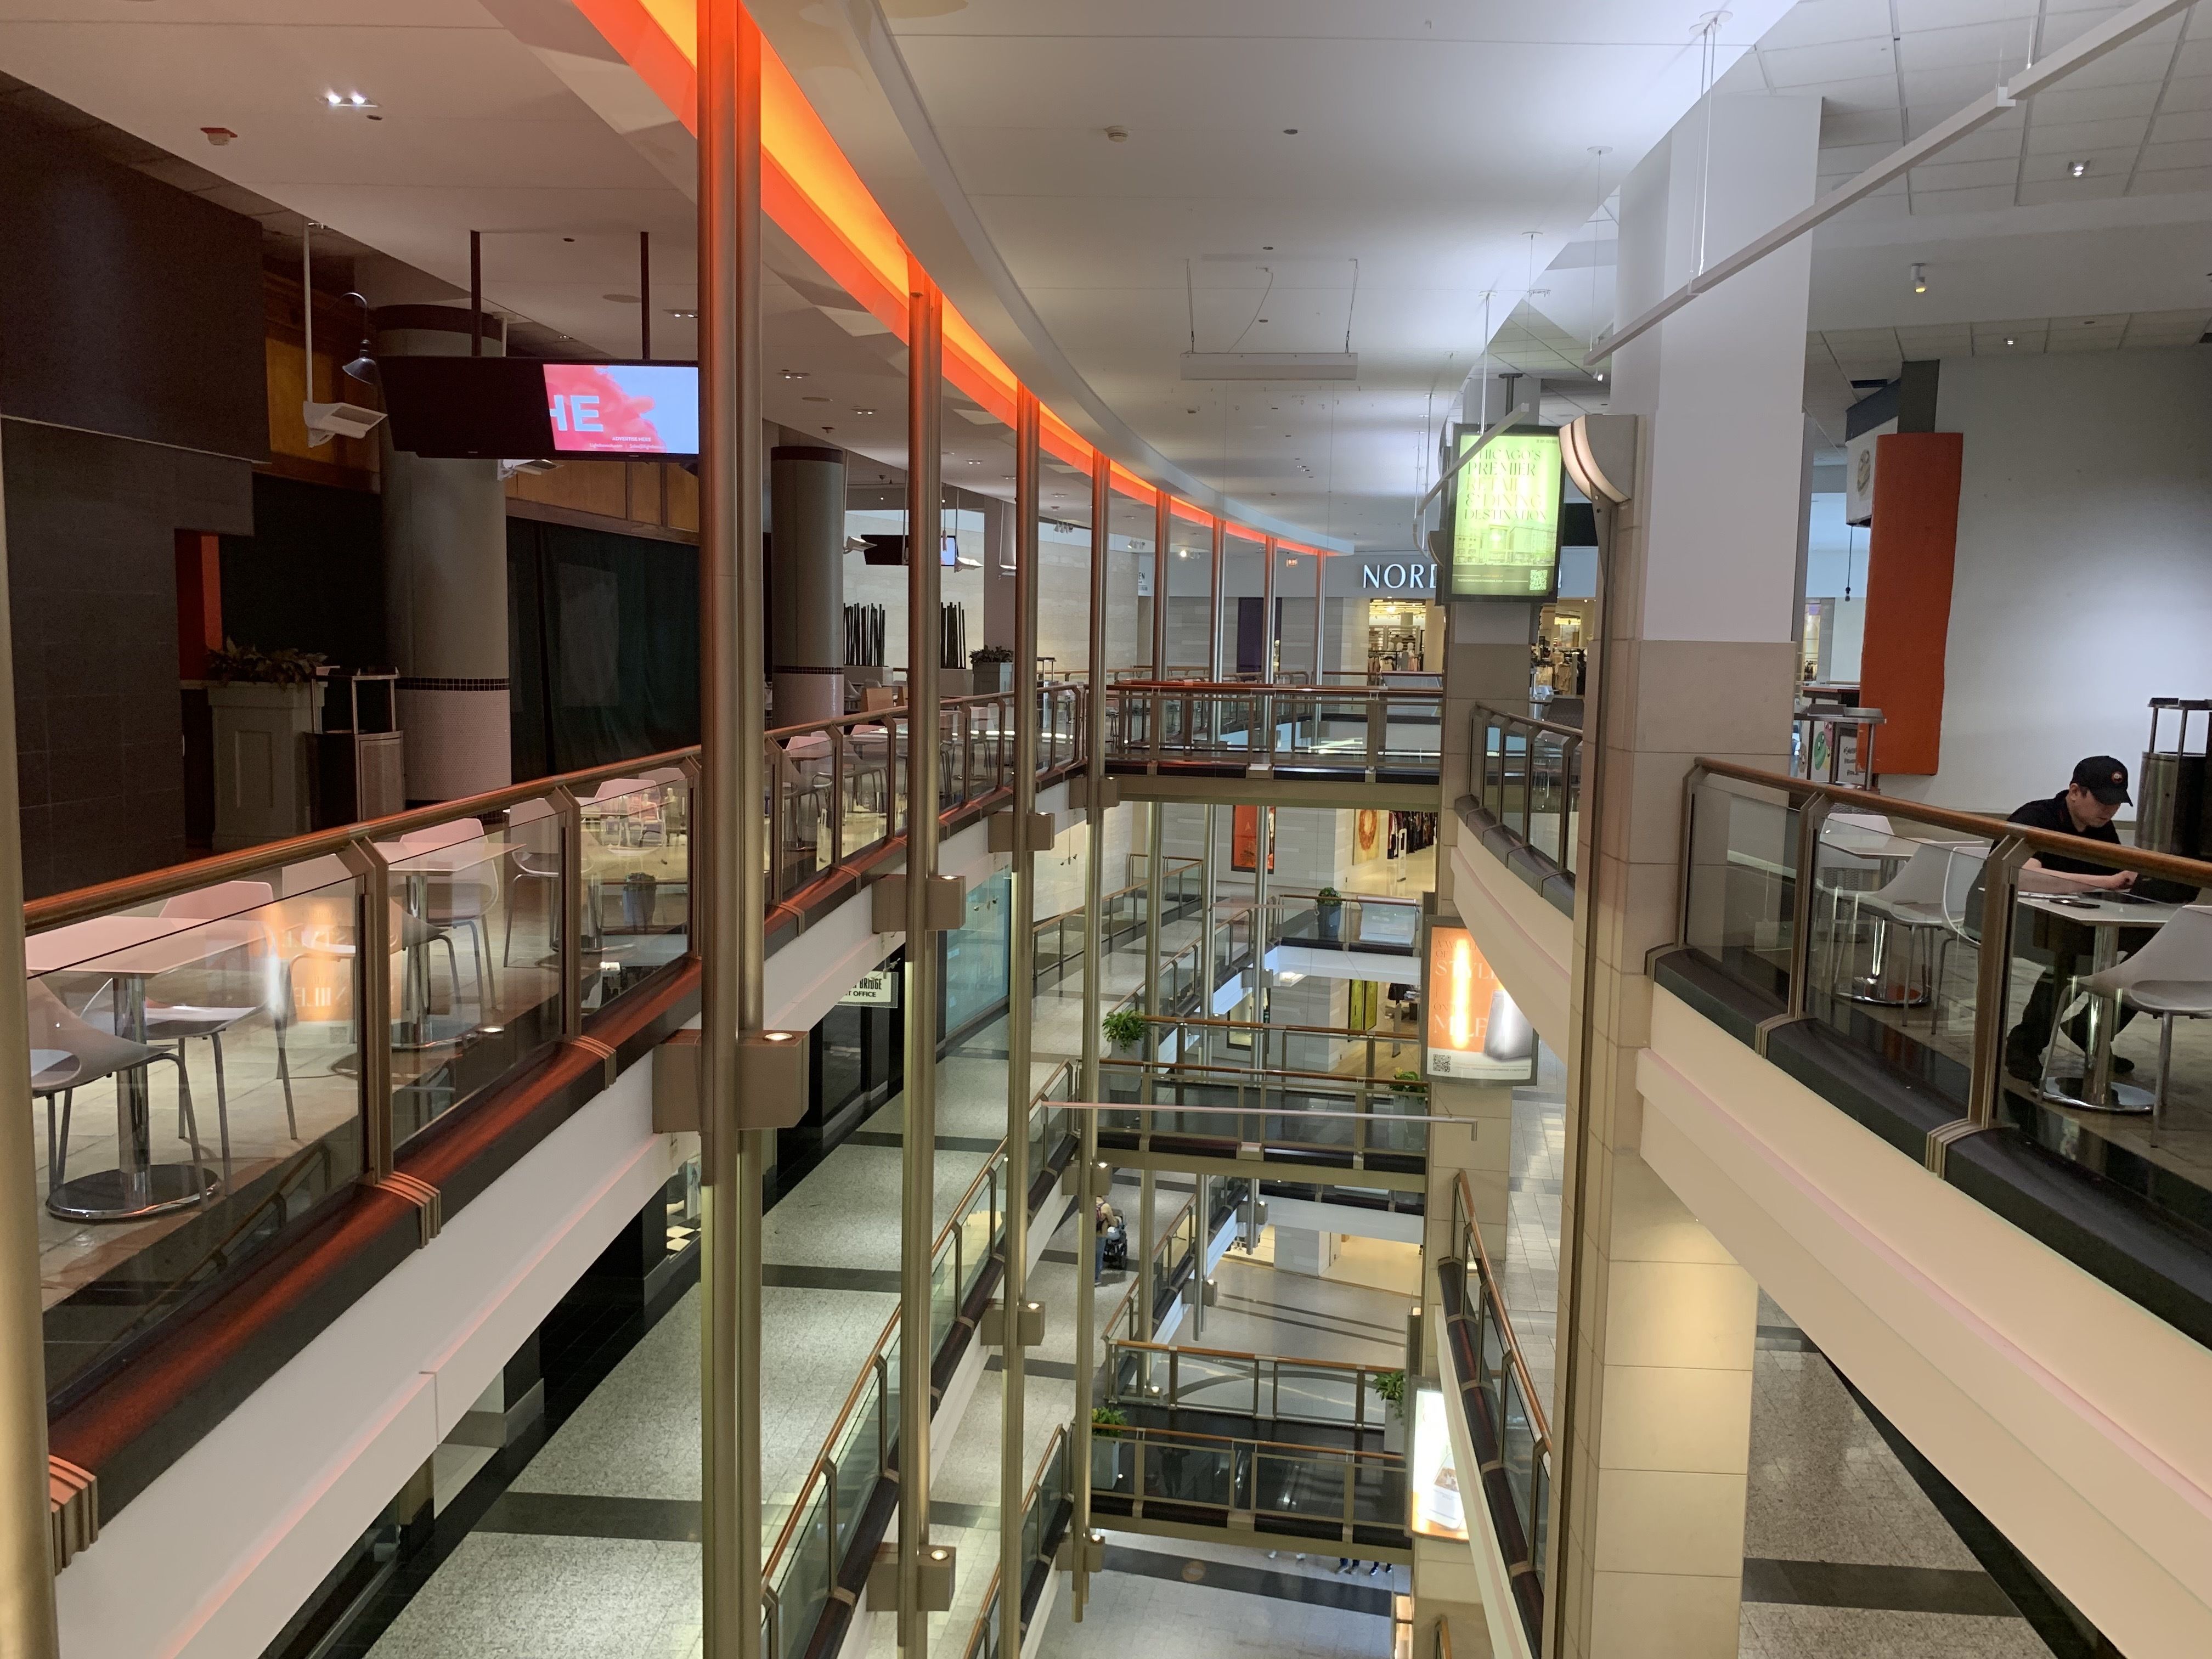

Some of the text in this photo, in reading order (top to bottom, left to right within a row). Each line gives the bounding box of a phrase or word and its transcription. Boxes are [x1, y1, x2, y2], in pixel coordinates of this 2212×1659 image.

[1479, 448, 1541, 461] HICAGO'S
[1468, 462, 1536, 476] PREMIER
[1483, 494, 1541, 508] DINING
[1465, 509, 1546, 520] DESTINATION
